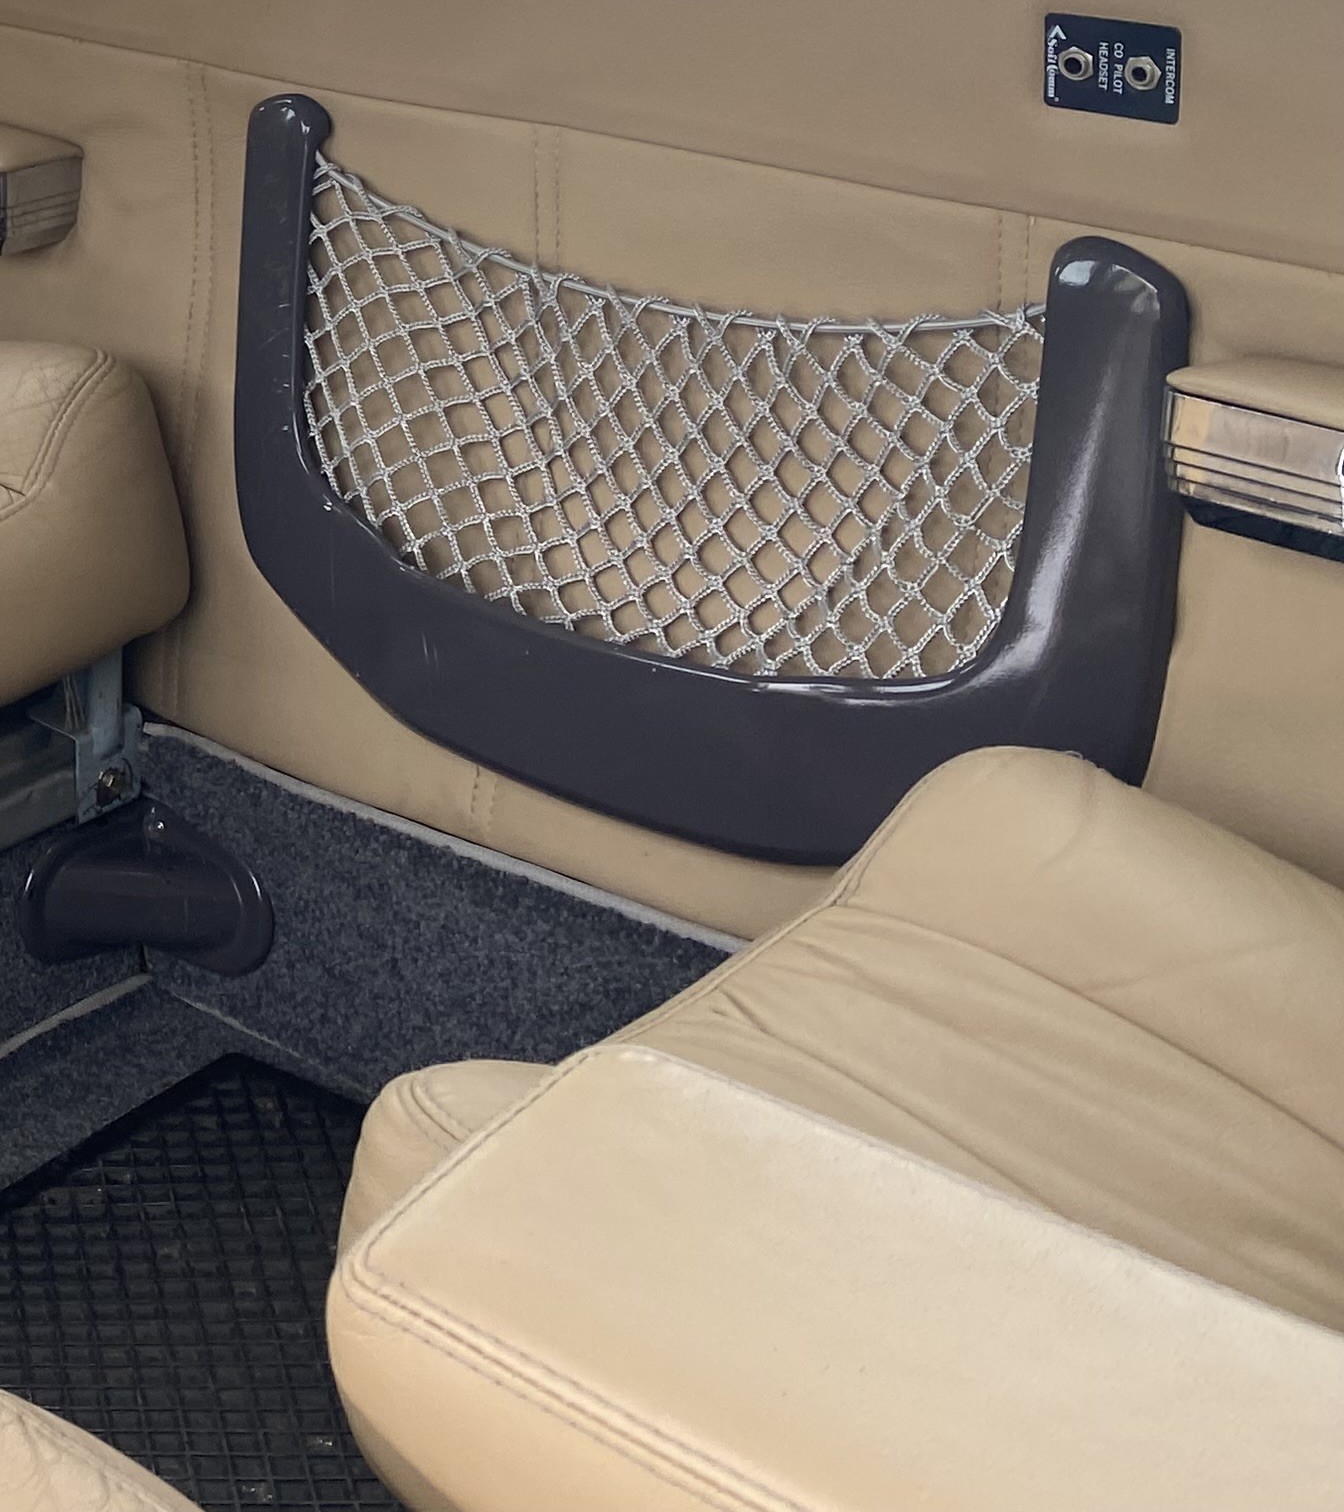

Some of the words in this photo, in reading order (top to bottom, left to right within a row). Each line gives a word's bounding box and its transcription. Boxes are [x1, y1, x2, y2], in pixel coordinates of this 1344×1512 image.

[1098, 41, 1110, 91] HEADSET
[1113, 42, 1125, 59] CO
[1112, 63, 1124, 95] PILOT
[1164, 48, 1176, 105] INTERCOM
